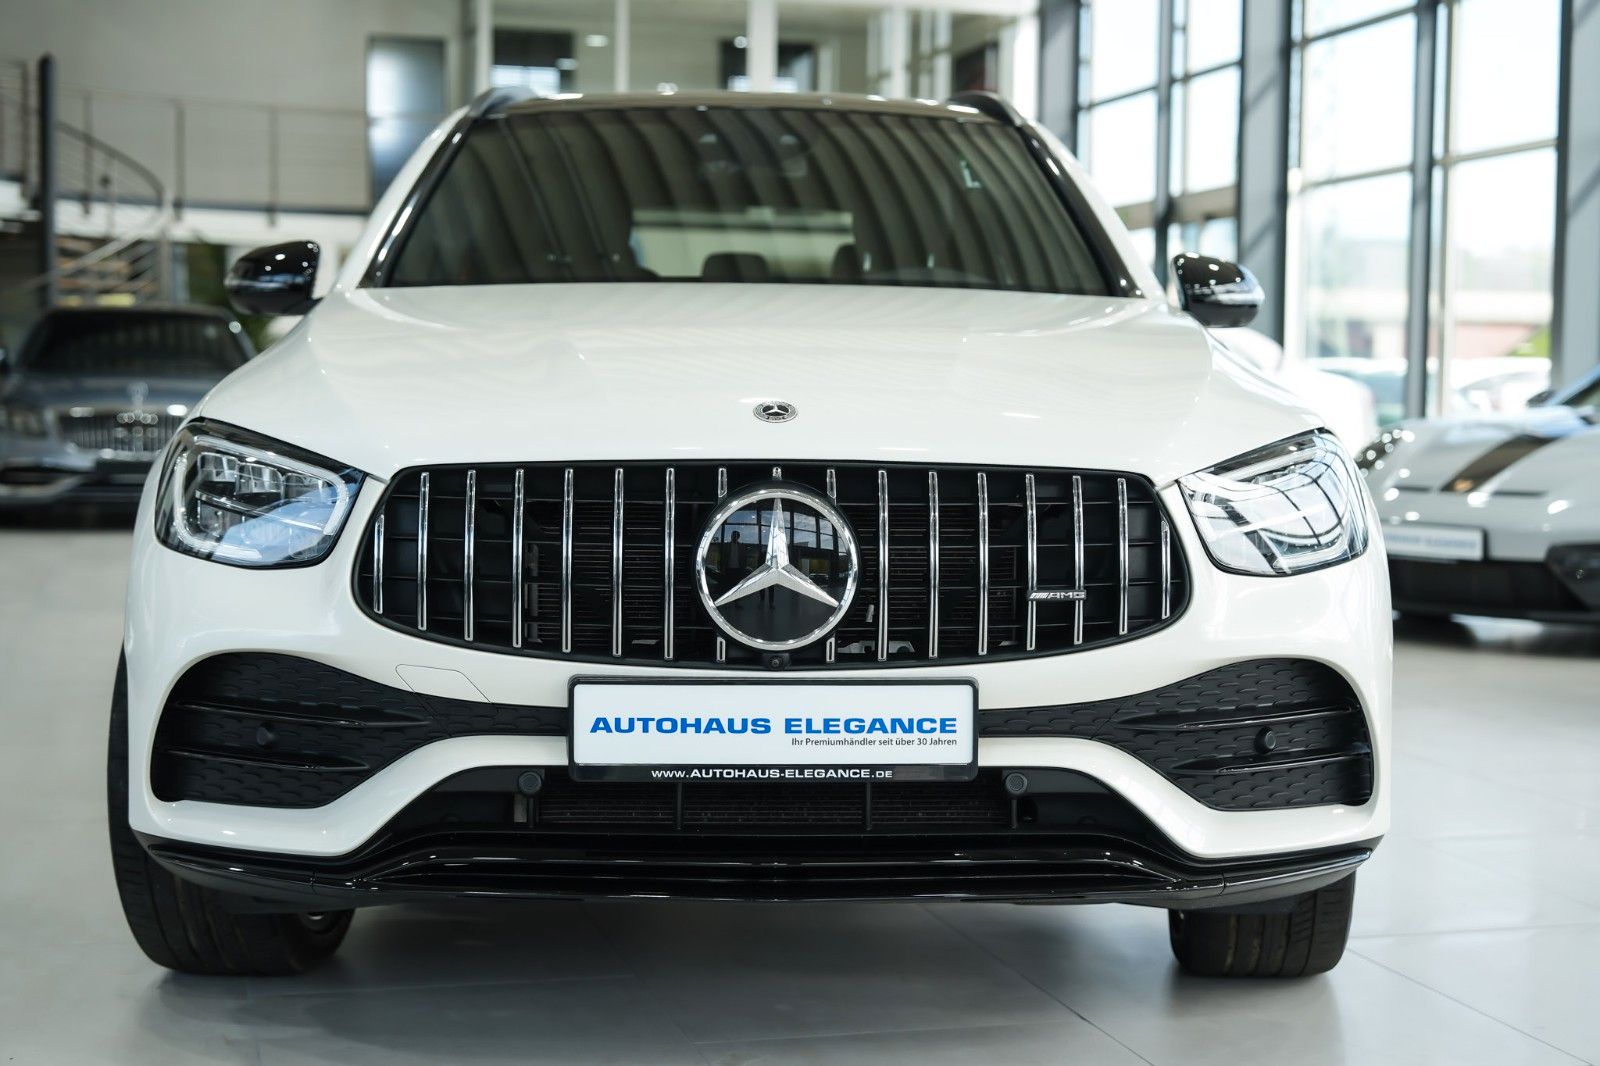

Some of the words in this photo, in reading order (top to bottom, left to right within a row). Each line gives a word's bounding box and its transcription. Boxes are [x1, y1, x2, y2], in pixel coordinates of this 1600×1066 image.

[1046, 591, 1086, 600] AMG
[590, 716, 771, 734] AUTOHAUS
[784, 717, 957, 735] ELEGANCE
[791, 737, 803, 746] Ihr
[805, 737, 877, 746] Premiumhändler
[878, 737, 894, 746] seit
[895, 737, 915, 746] über
[917, 737, 928, 746] 30
[929, 737, 958, 747] Jahren
